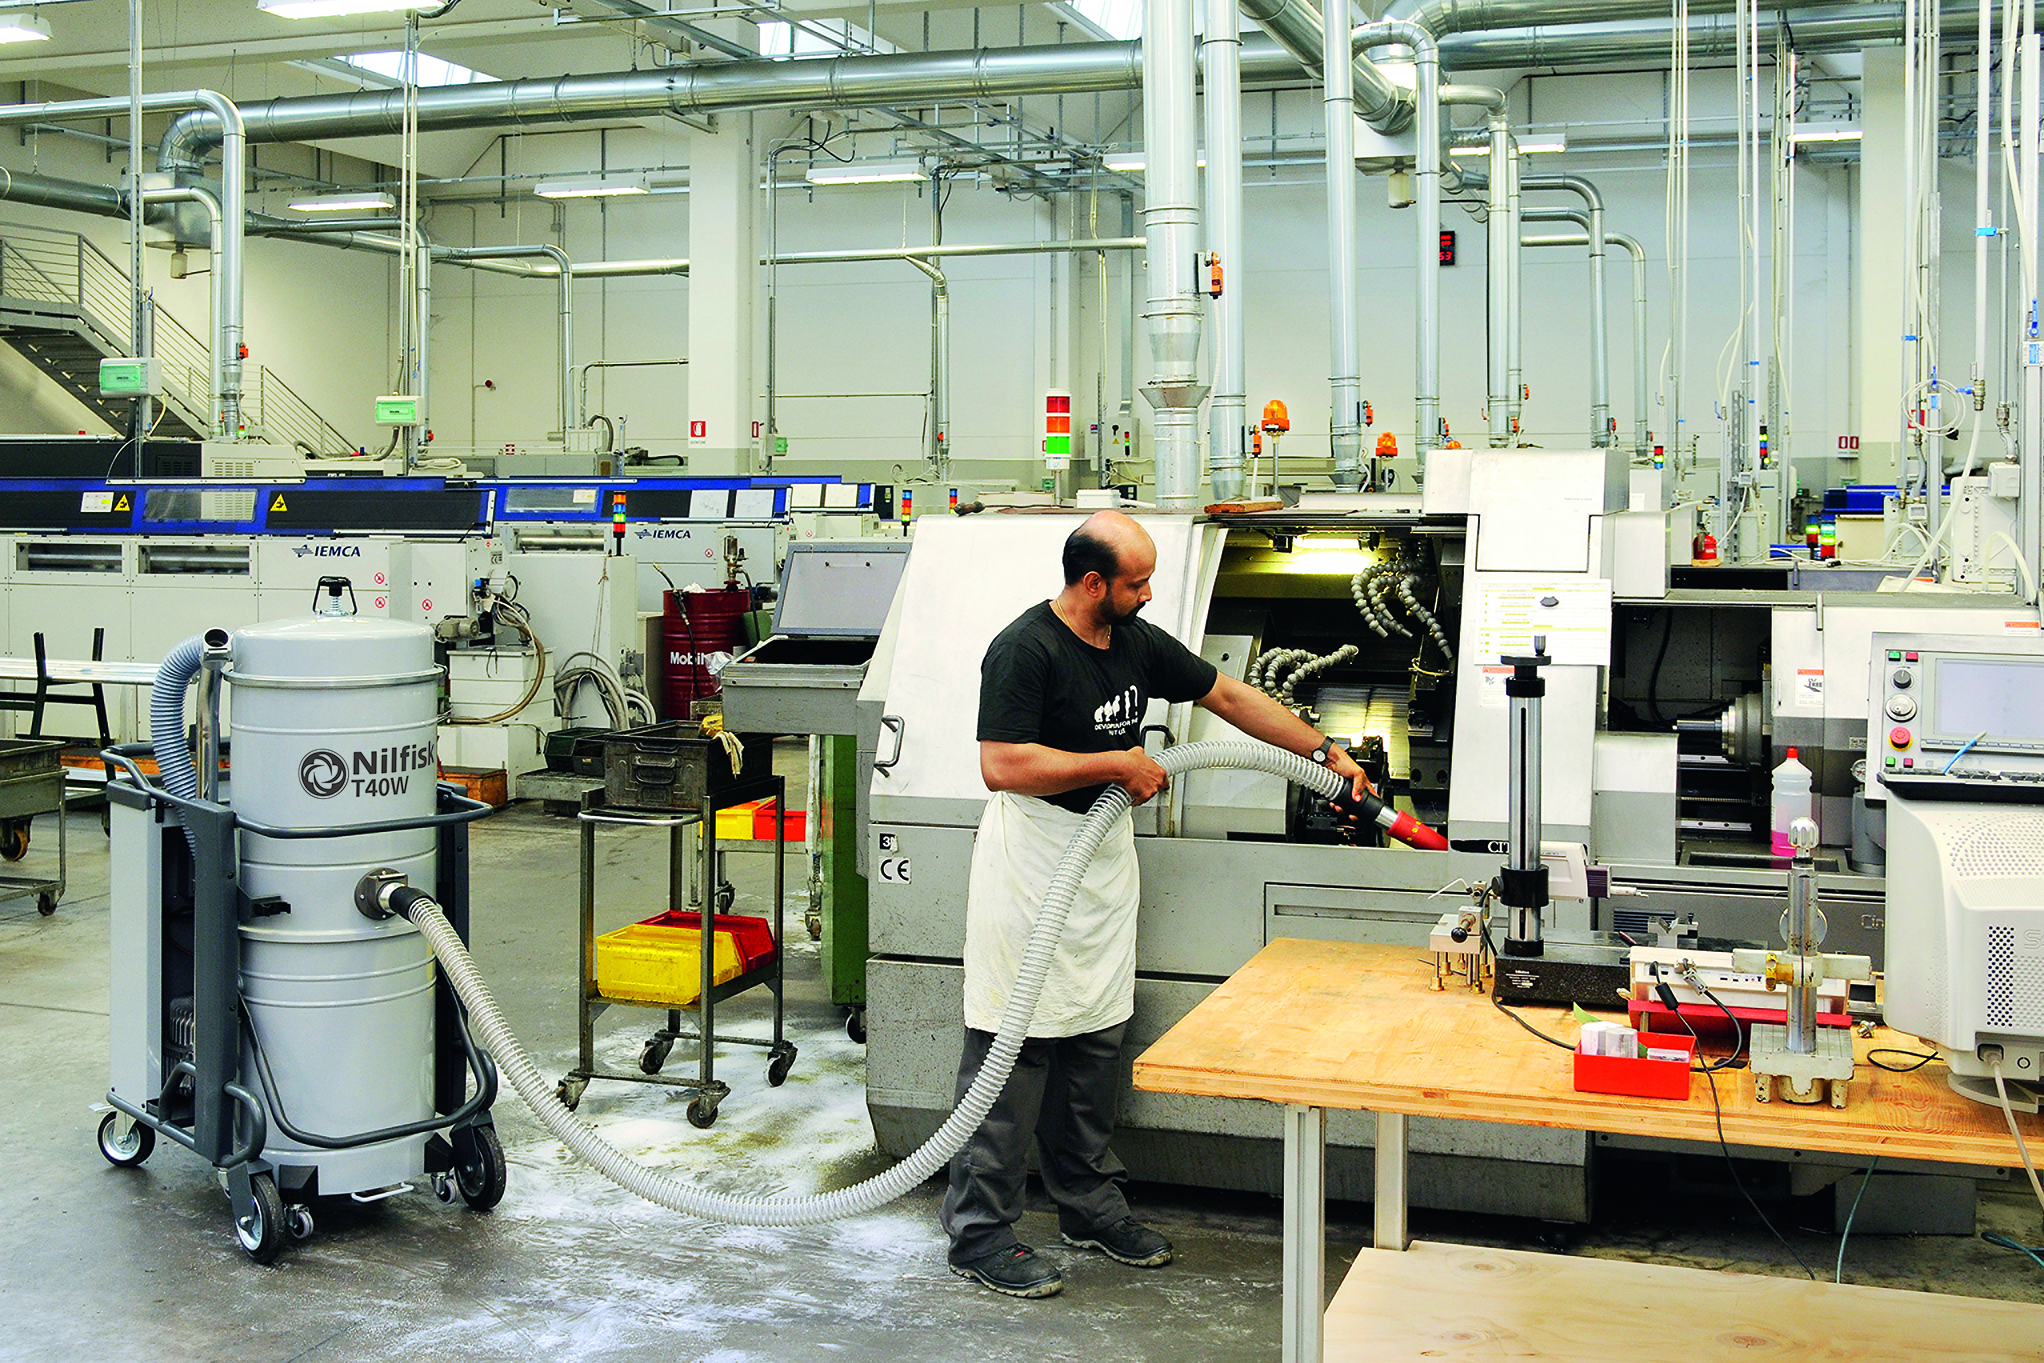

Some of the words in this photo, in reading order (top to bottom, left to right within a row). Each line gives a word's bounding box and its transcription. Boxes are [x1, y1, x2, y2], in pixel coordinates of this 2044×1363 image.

[652, 529, 691, 539] IEMCA
[314, 545, 361, 557] IEMCA
[353, 741, 435, 775] Nilfisk
[351, 775, 409, 797] T40W
[880, 858, 910, 881] CE
